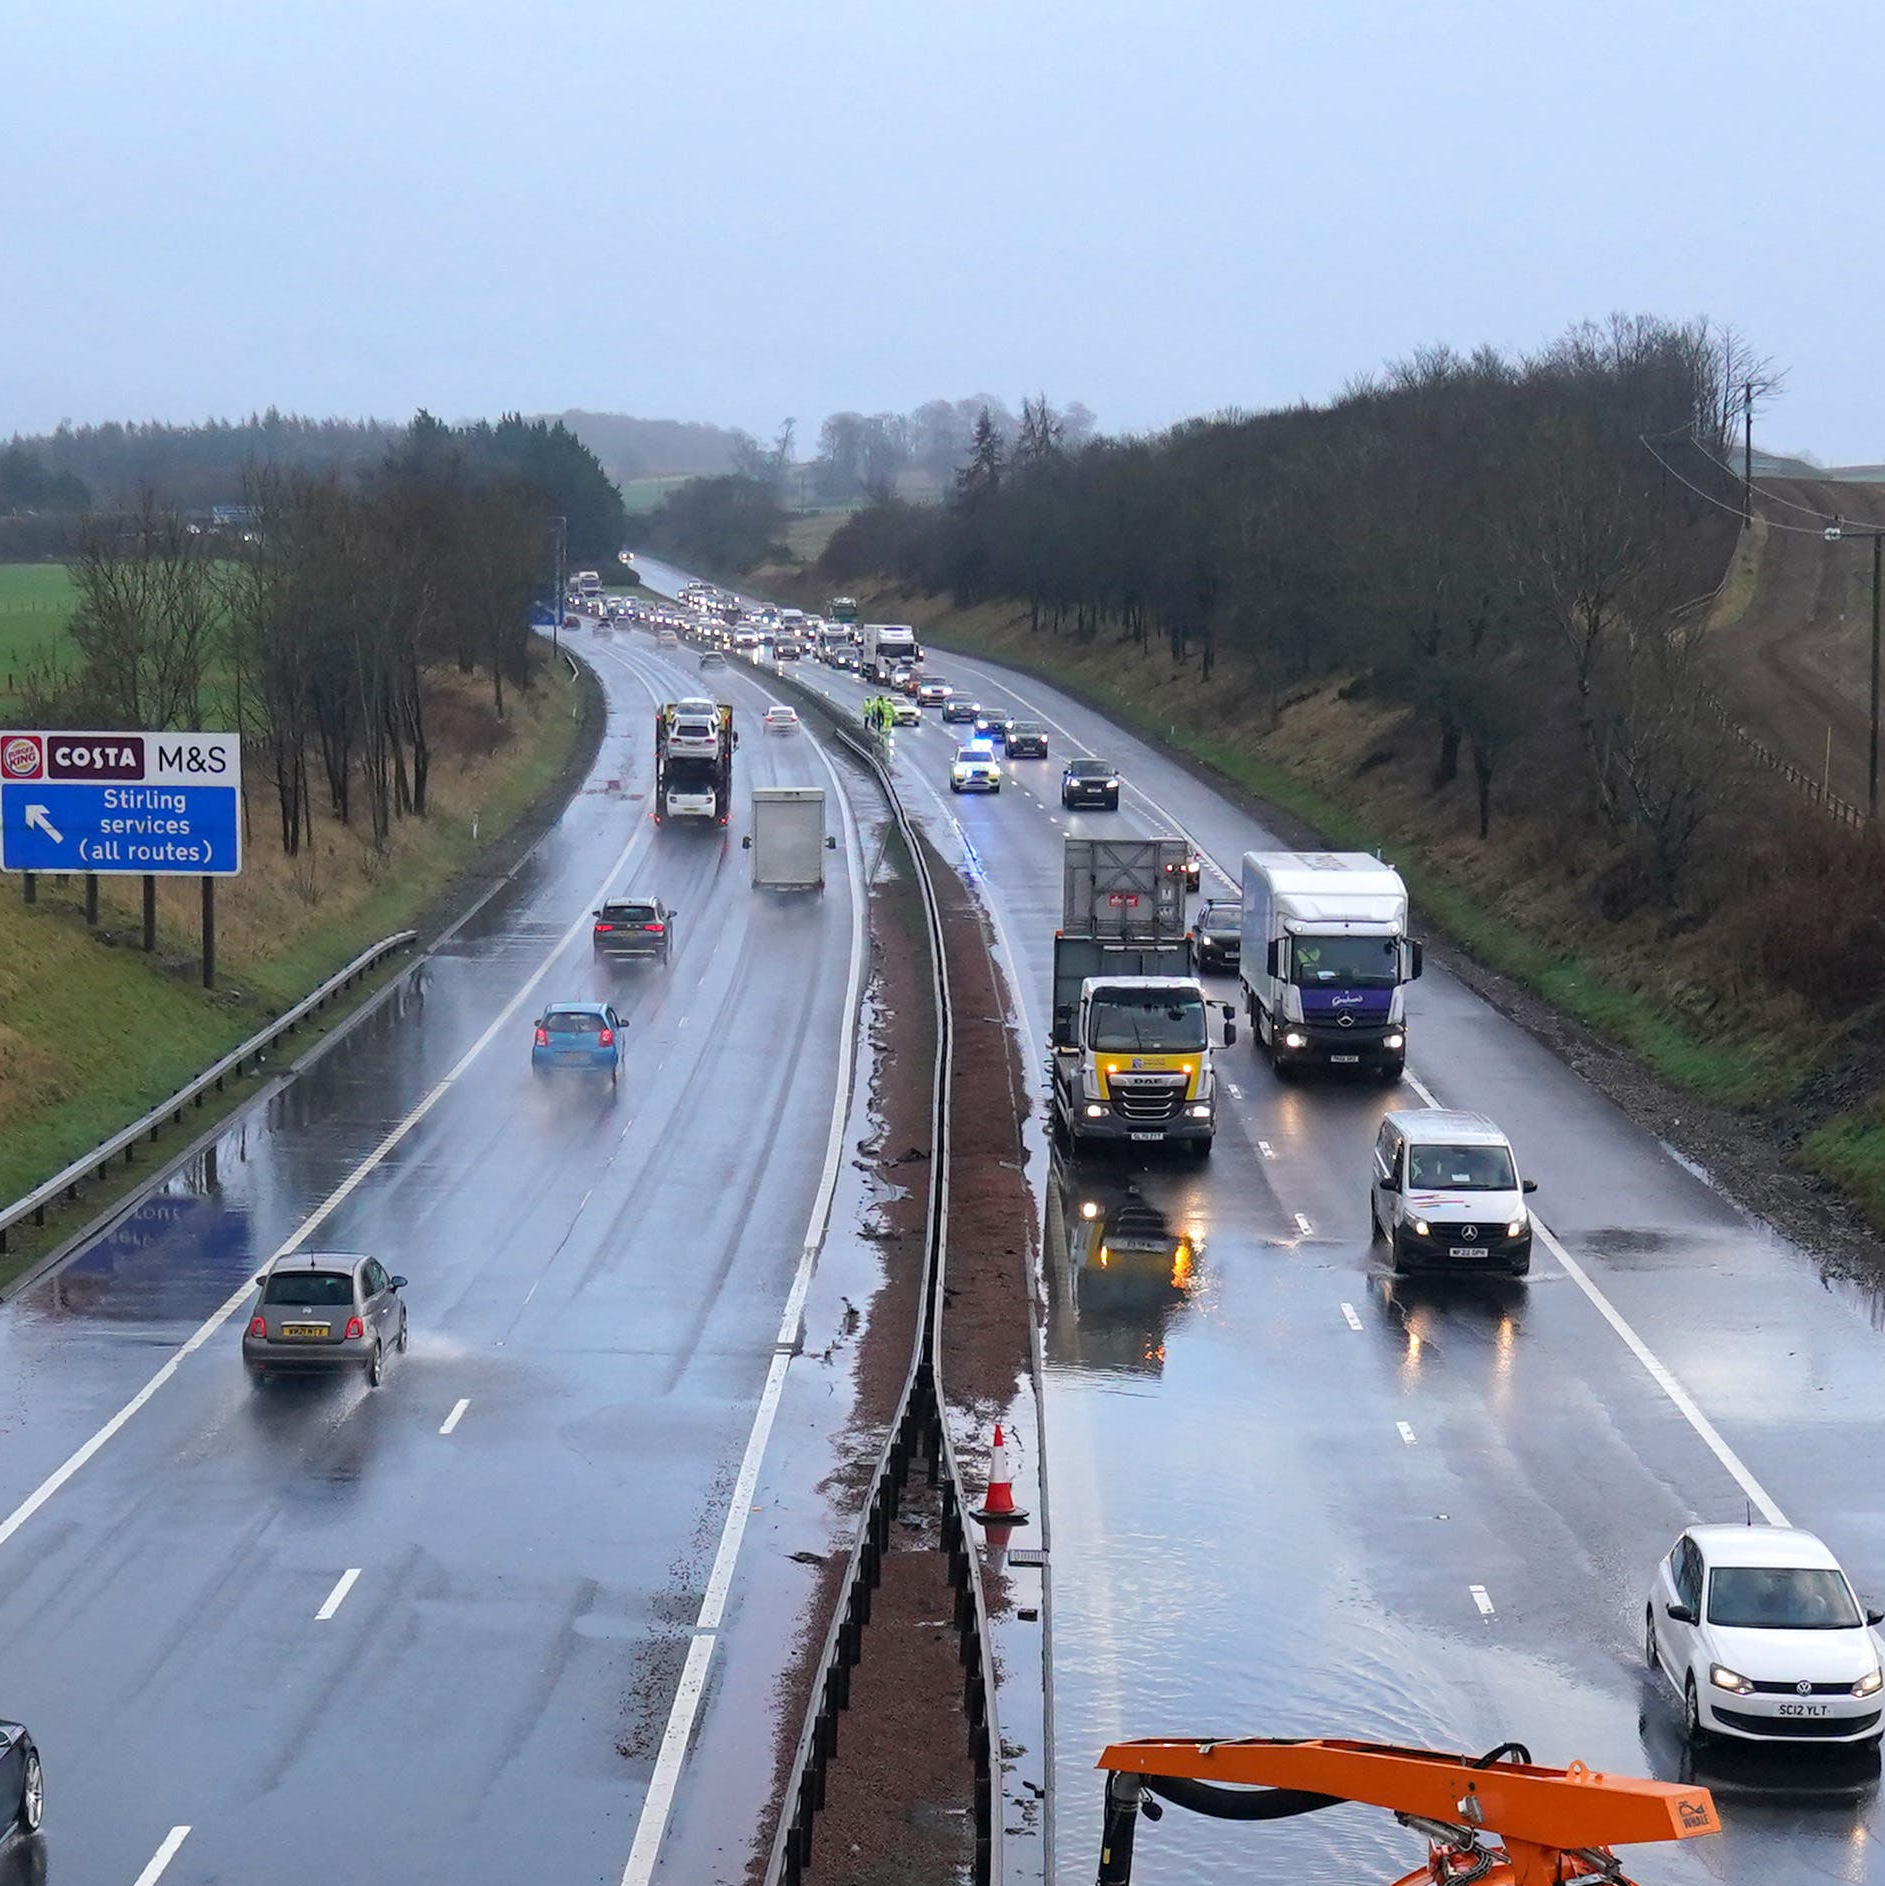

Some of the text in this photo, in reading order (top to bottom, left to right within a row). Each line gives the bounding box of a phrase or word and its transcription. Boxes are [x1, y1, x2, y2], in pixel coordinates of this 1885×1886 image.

[9, 754, 36, 767] KING
[55, 747, 137, 769] COSTA
[158, 745, 226, 773] M&S
[104, 789, 186, 813] Stirling
[100, 816, 190, 834] services
[79, 838, 213, 863] (all routes)
[1779, 1704, 1827, 1716] SC12 YLT
[1682, 1814, 1710, 1829] WHALE
